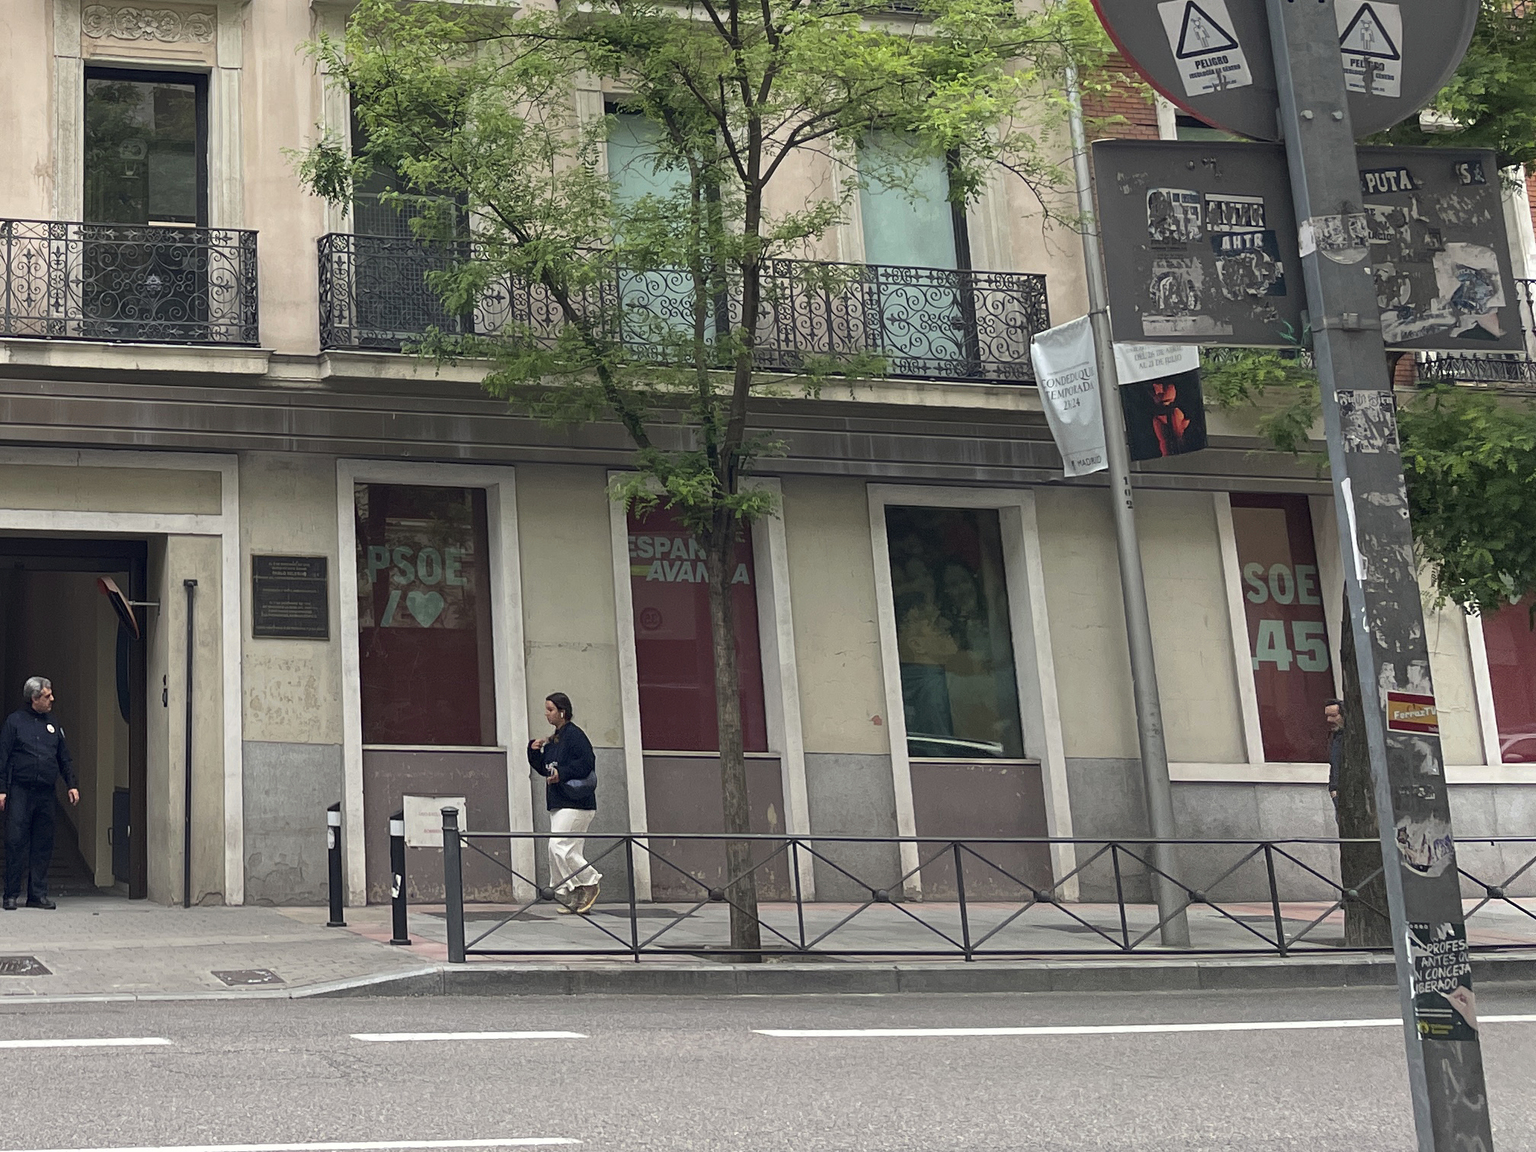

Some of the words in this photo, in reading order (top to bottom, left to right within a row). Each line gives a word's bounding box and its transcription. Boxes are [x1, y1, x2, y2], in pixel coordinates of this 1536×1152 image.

[1195, 55, 1229, 70] PELIGRO
[1365, 170, 1412, 193] PUTA
[1077, 455, 1102, 468] MADRID
[366, 544, 468, 586] PSOE
[645, 560, 751, 585] AVANA
[1243, 562, 1322, 606] SOE
[1251, 619, 1330, 673] 45
[1393, 707, 1438, 720] FerrazTV
[1421, 952, 1457, 968] ANTES
[1425, 963, 1472, 981] CONCEJA
[1415, 977, 1458, 995] IBERADO
